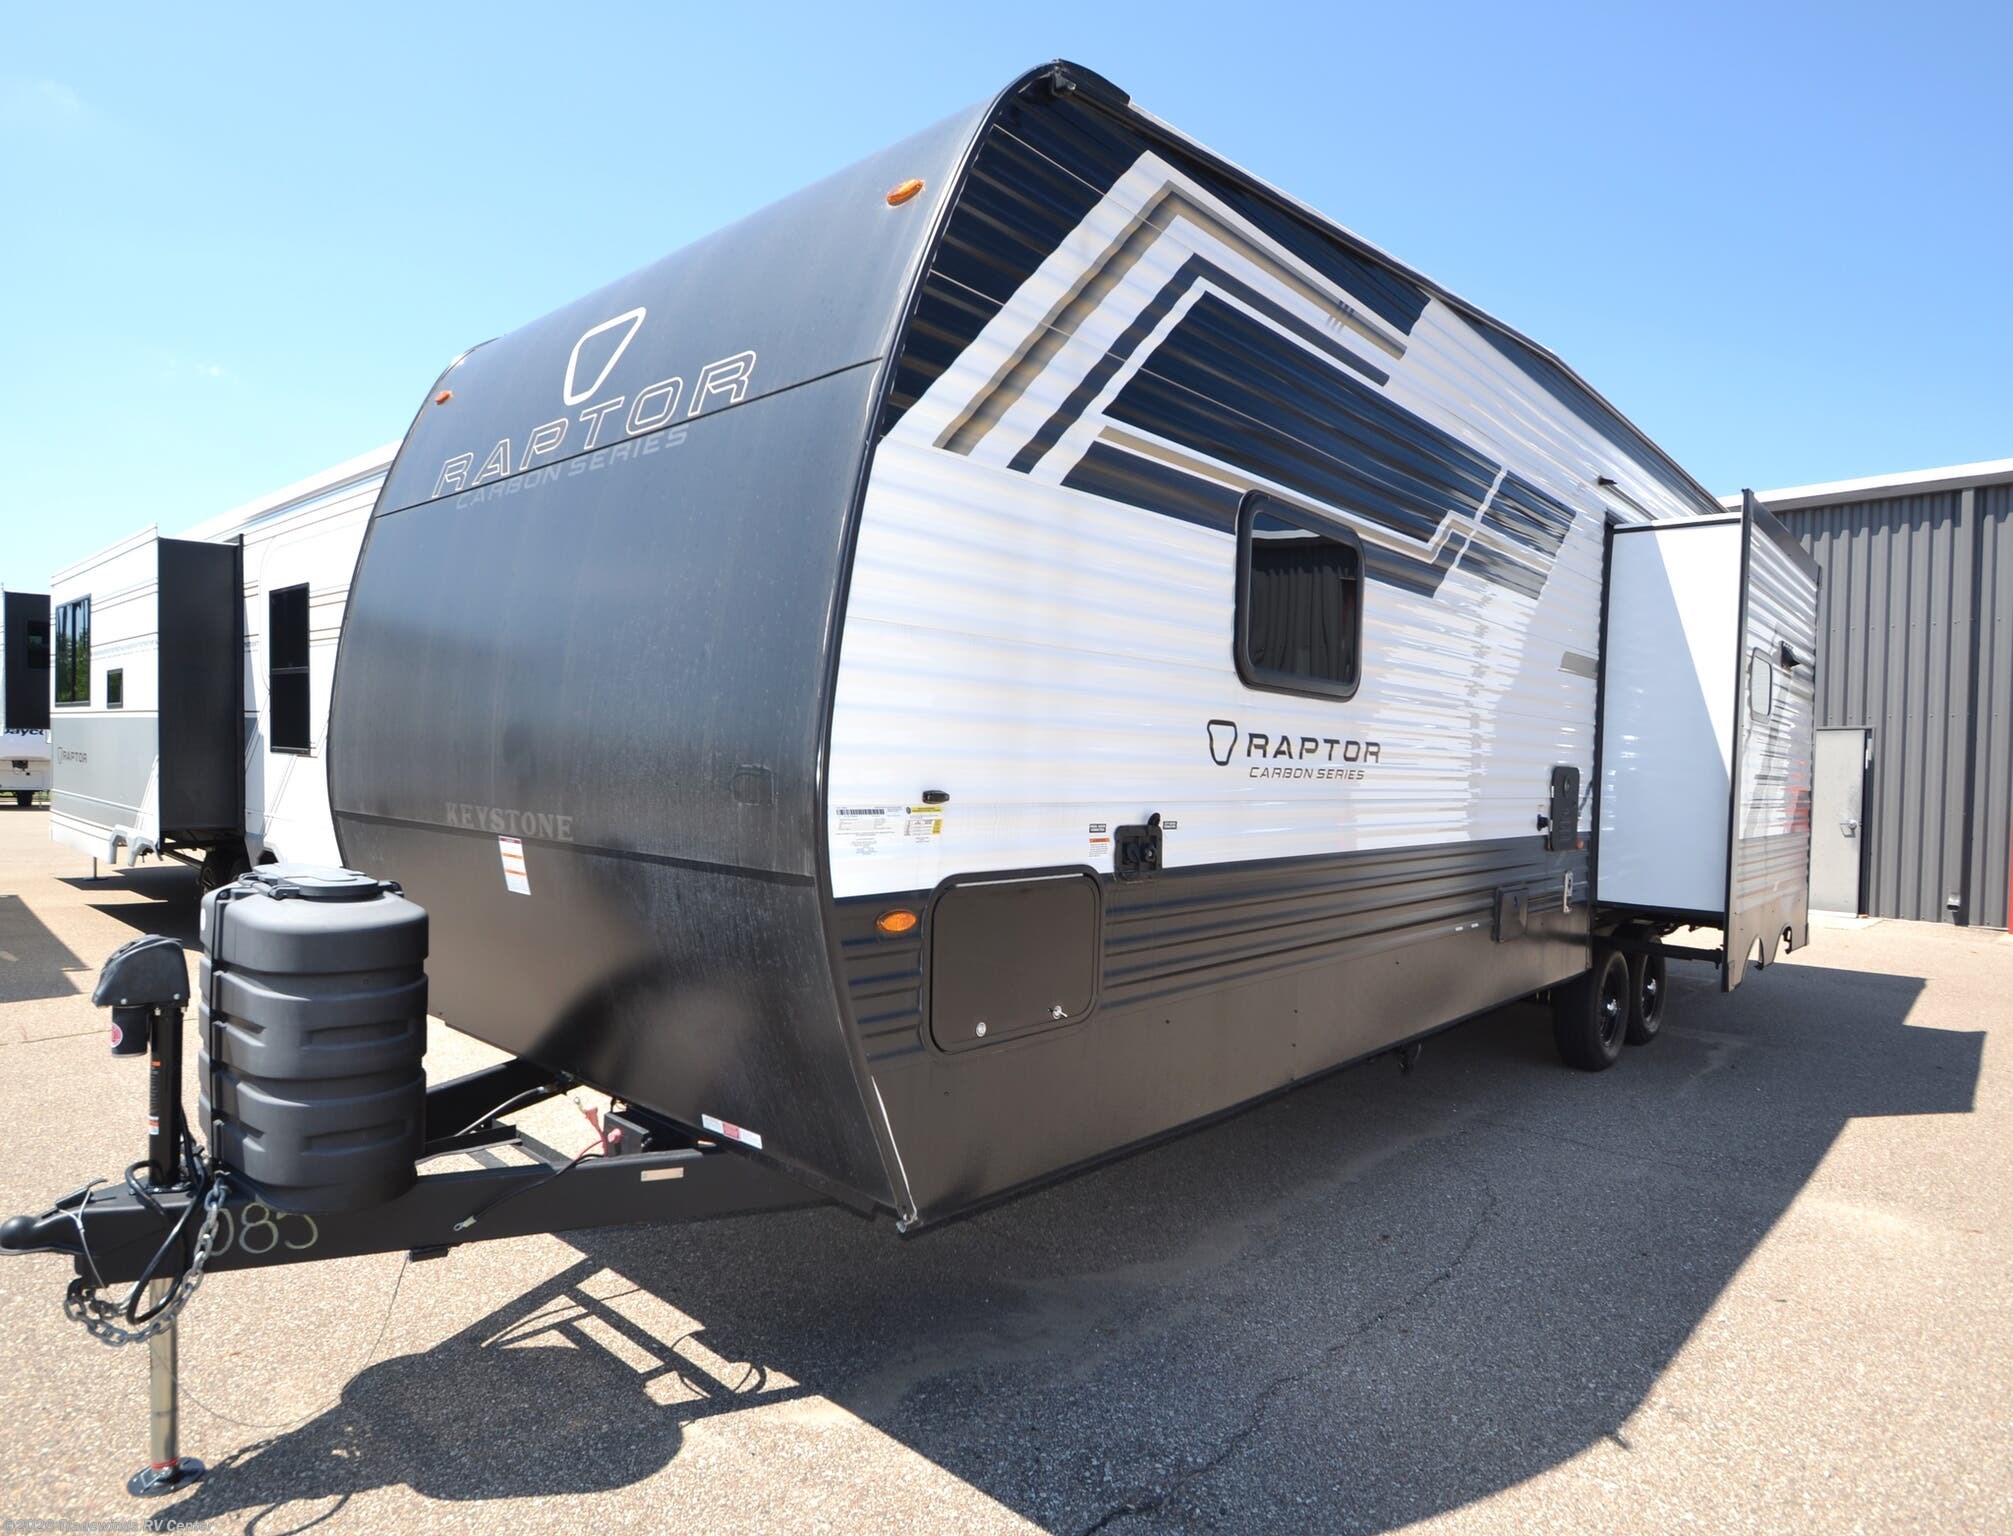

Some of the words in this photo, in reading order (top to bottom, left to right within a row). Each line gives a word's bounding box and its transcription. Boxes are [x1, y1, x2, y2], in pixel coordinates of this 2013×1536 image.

[432, 350, 757, 499] RAPTOR
[456, 467, 561, 509] CARBON
[568, 426, 689, 475] SERIES
[1246, 732, 1381, 763] RAPTOR
[1249, 767, 1315, 779] CARBON
[1316, 769, 1366, 780] SERIES
[446, 802, 574, 841] KEYSTONE
